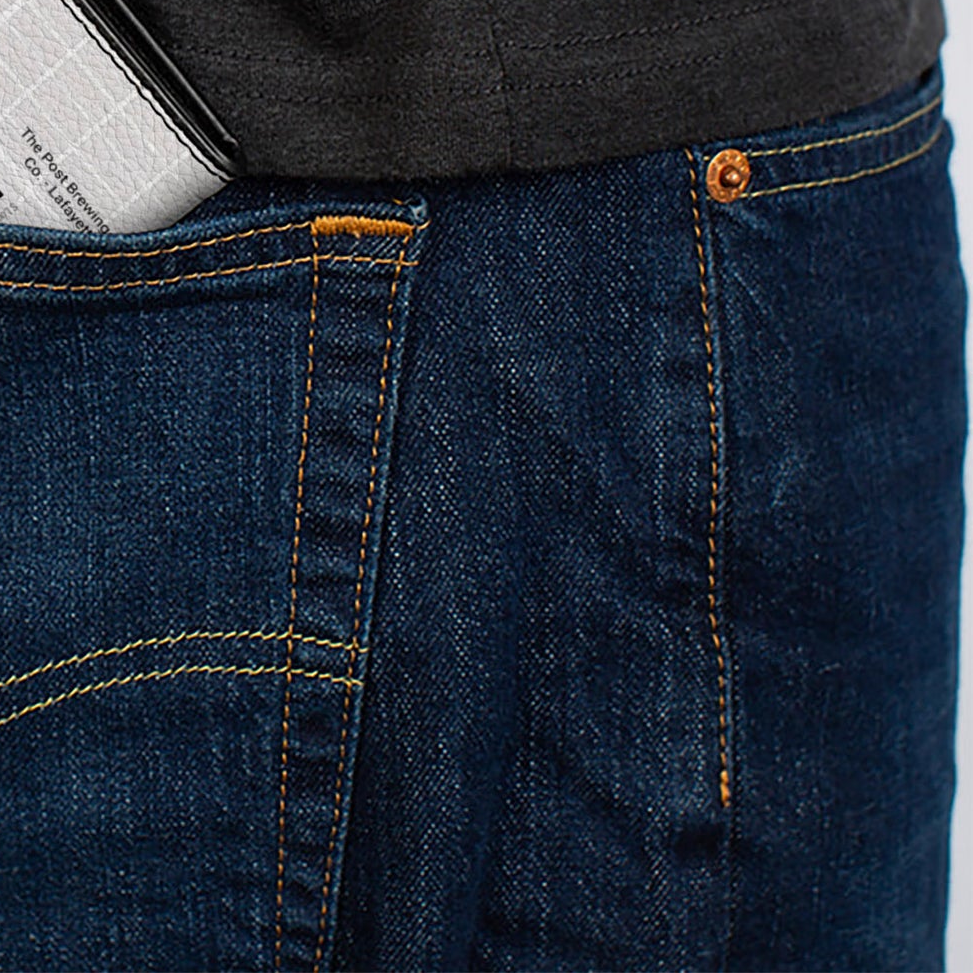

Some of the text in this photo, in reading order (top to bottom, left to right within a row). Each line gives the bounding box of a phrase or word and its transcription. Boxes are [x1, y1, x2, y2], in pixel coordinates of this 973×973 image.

[20, 126, 111, 235] The Post Brewing
[23, 155, 42, 181] Co.
[47, 185, 90, 234] Lafayet
